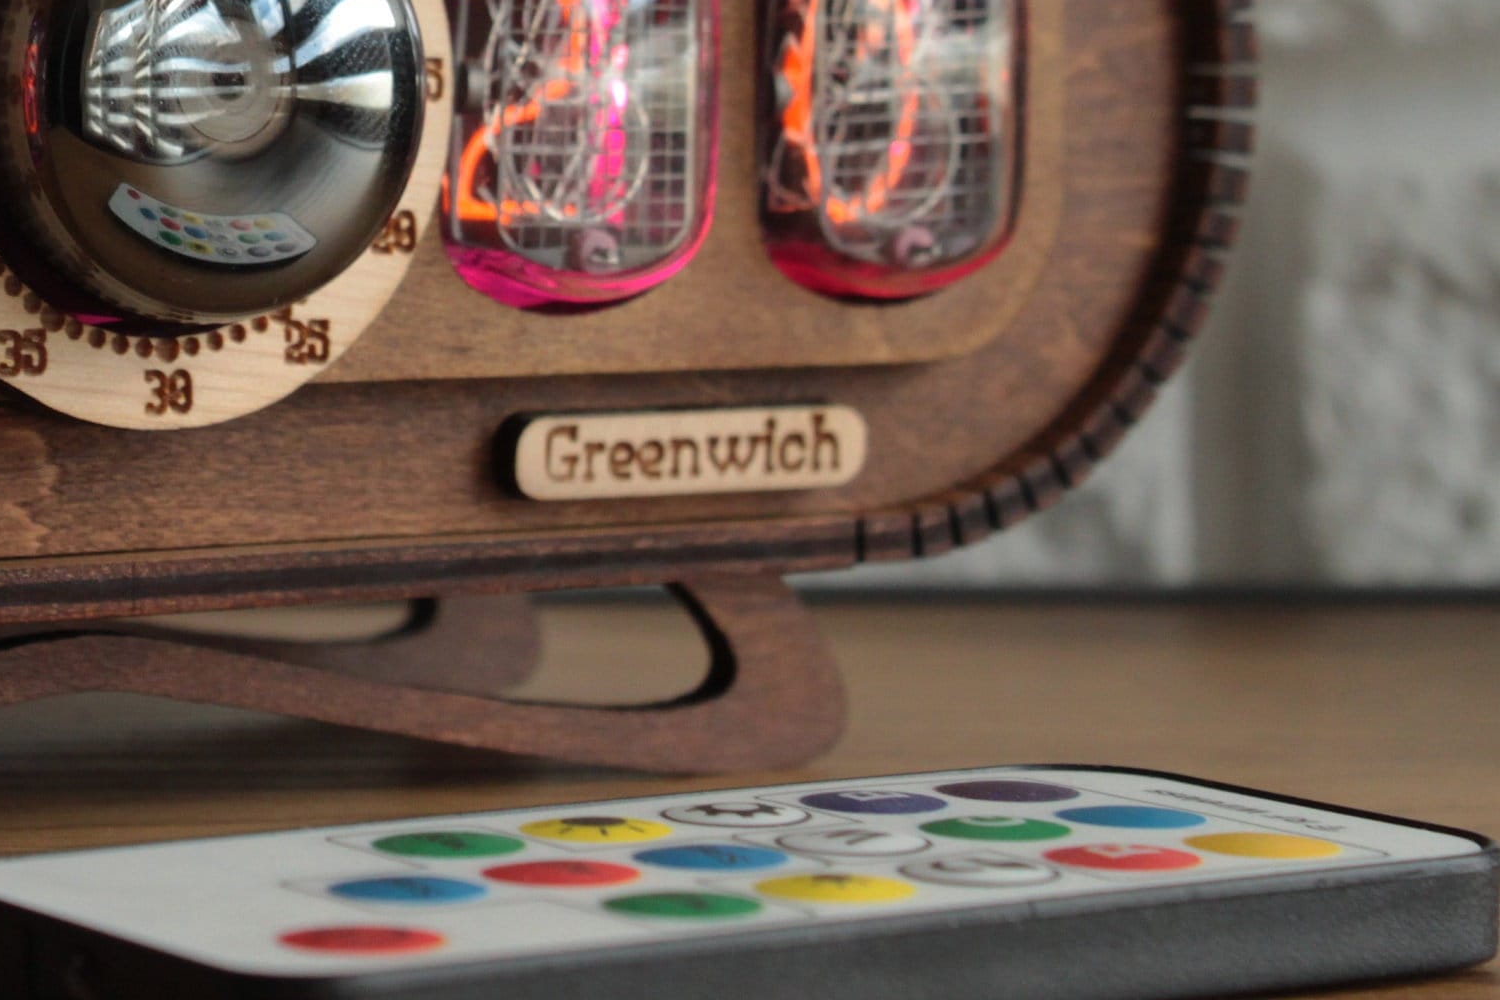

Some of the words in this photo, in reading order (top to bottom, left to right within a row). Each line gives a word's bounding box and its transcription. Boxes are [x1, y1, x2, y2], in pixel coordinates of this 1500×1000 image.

[425, 57, 444, 102] 5
[284, 318, 330, 365] 25
[144, 369, 193, 414] 30
[543, 413, 842, 483] Greenwich
